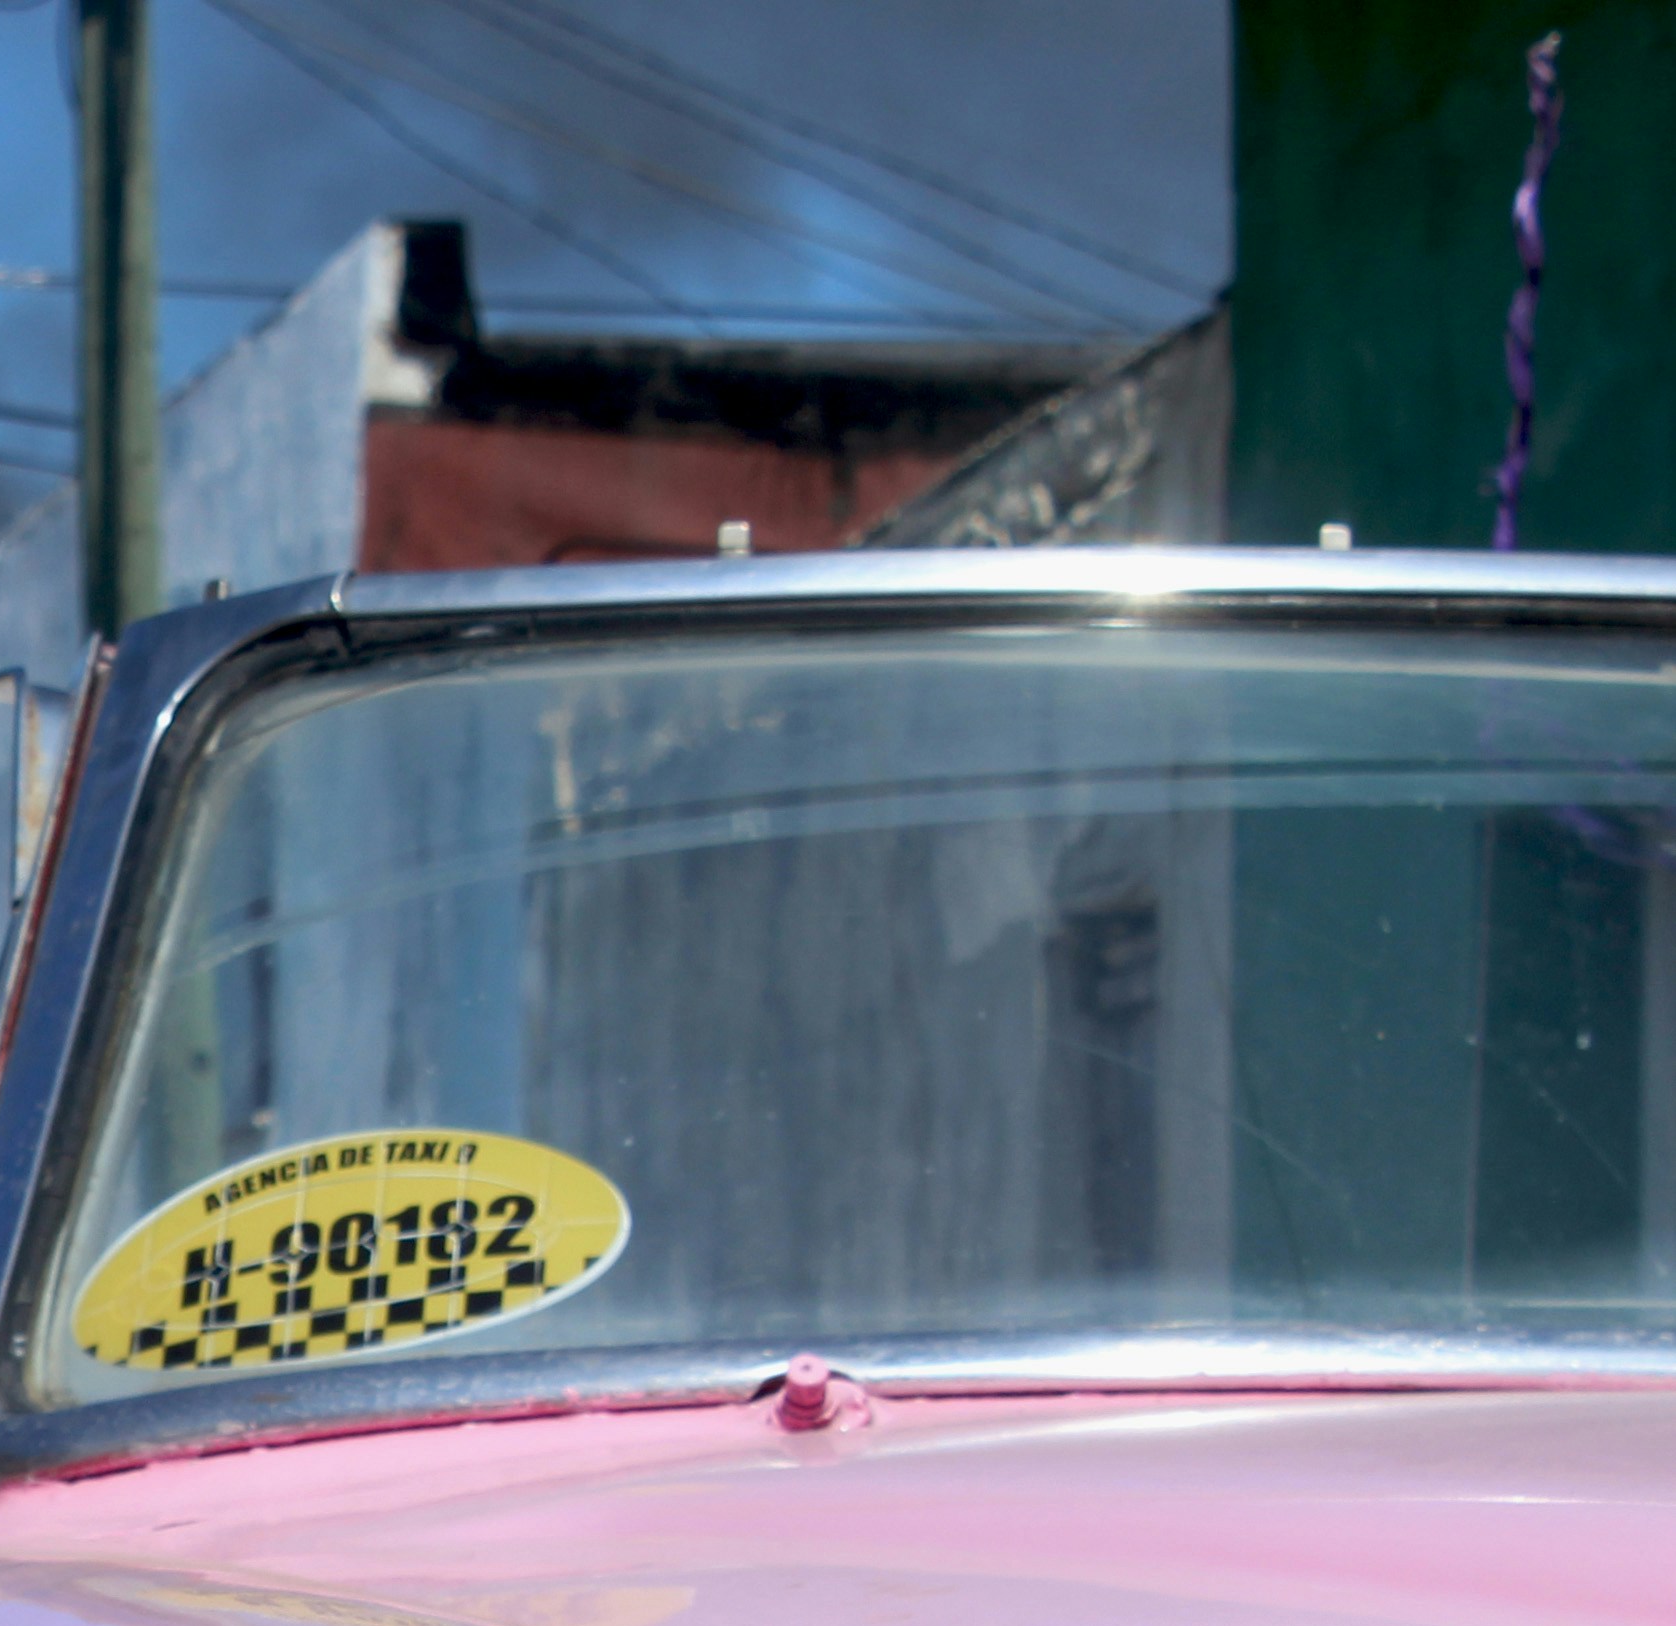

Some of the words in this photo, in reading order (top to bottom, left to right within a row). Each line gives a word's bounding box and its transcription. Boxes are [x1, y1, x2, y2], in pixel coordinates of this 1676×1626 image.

[204, 1154, 329, 1213] AGENCIA
[339, 1145, 374, 1169] DE
[385, 1142, 450, 1163] TAXI
[182, 1195, 536, 1309] H-90182
